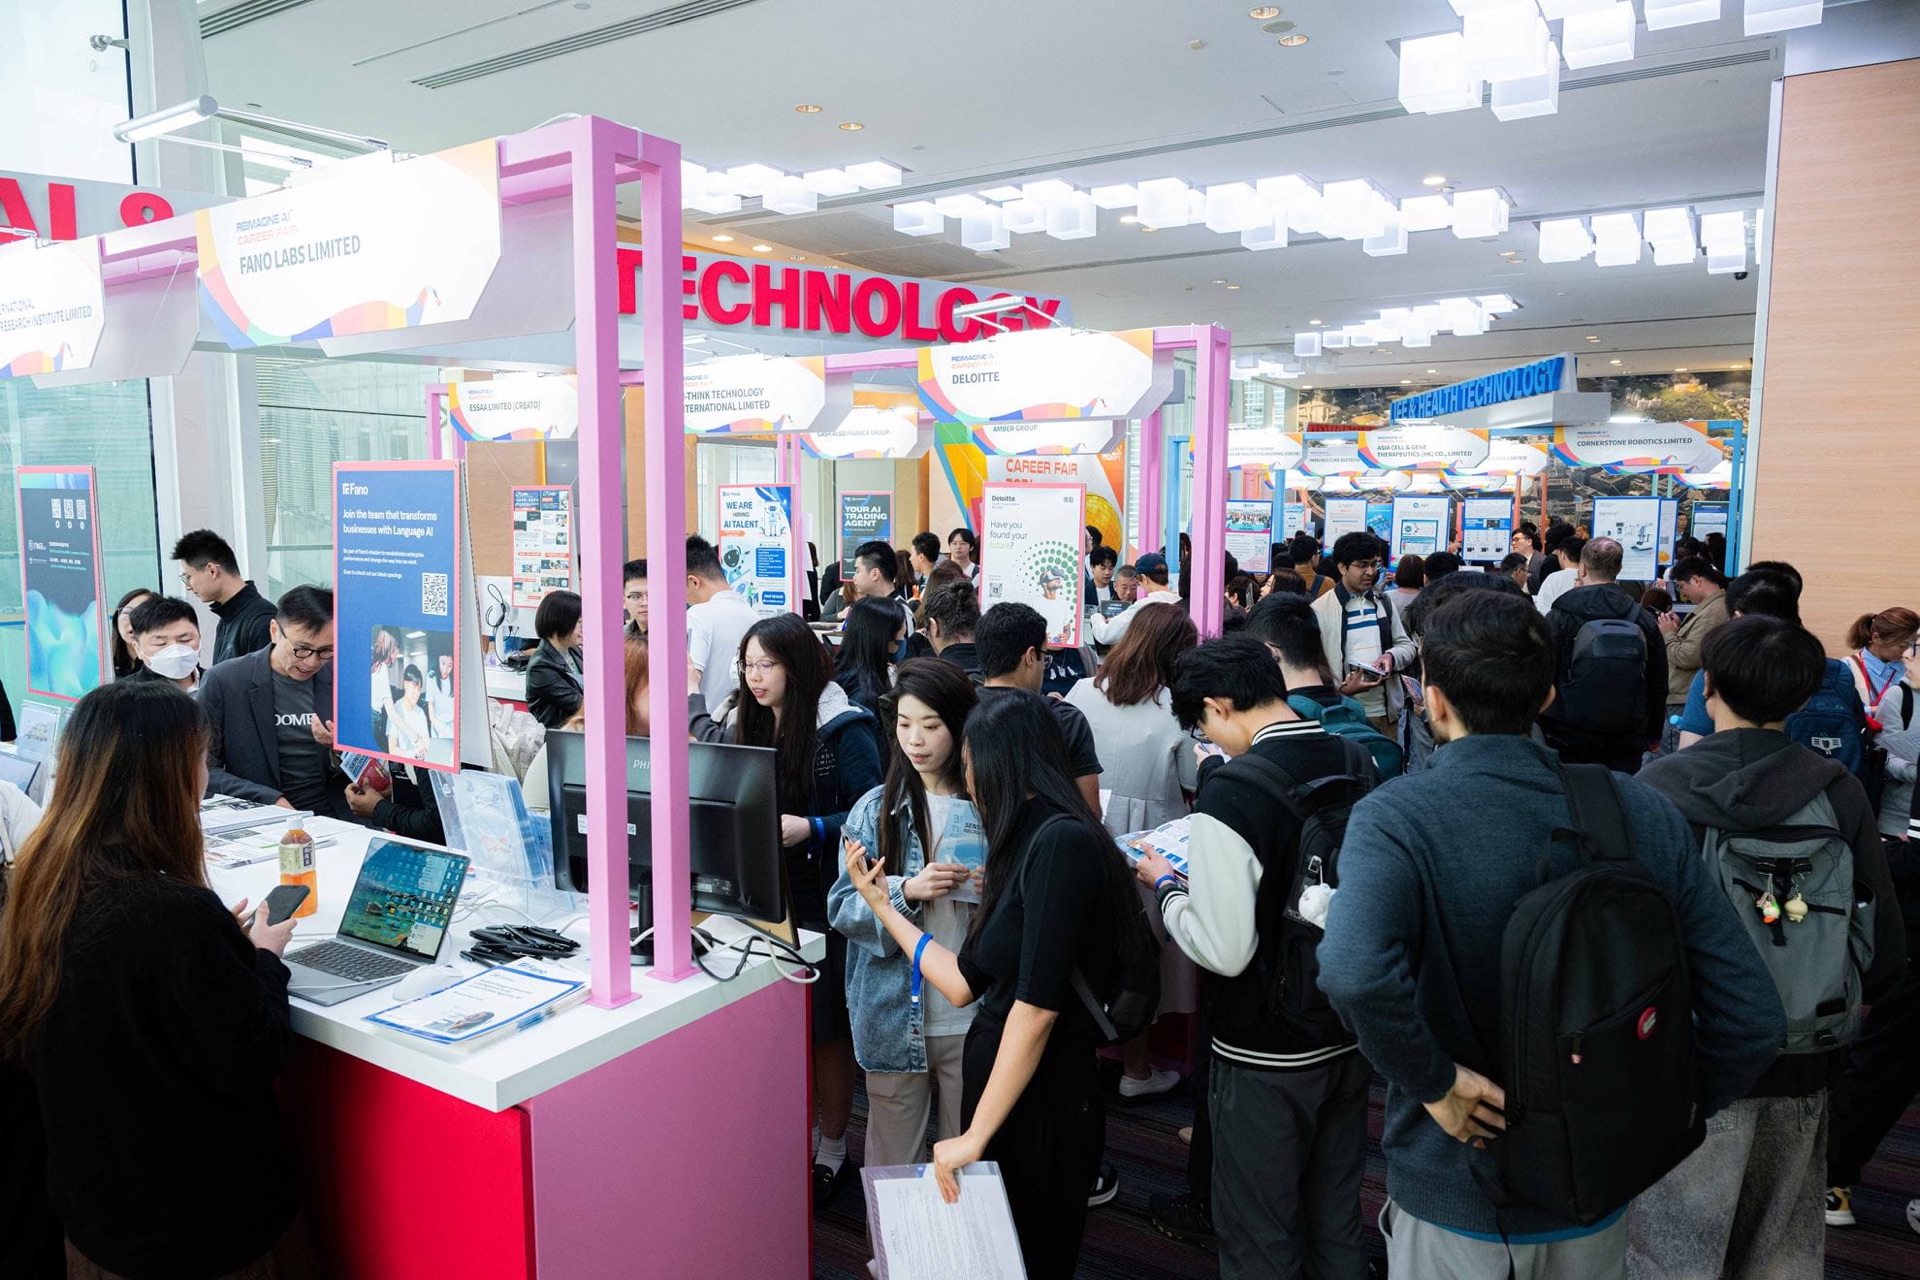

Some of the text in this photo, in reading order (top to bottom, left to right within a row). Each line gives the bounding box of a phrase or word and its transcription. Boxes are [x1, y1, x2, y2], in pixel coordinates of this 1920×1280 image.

[236, 214, 280, 233] REIMAGINE
[237, 230, 274, 246] CAREER
[240, 235, 360, 274] FANO LABS LIMITED
[32, 309, 64, 327] INSTITUTE
[65, 304, 92, 322] LIMITED
[952, 372, 1000, 384] DELOITTE
[712, 388, 764, 399] TECHNOLOGY
[1418, 385, 1458, 418] HEALTH
[1461, 357, 1565, 407] TECHNOLOGY
[470, 400, 540, 412] ESSAA LIMITED (CREATO)
[738, 400, 770, 410] LIMITED
[993, 424, 1038, 432] AMBER GROUP
[1577, 439, 1626, 447] CORNERSTONE
[1628, 438, 1663, 446] ROBOTICS
[1006, 458, 1078, 476] CAREER FAIR
[350, 483, 368, 495] Fano
[726, 502, 752, 510] WE ARE
[343, 510, 438, 520] Join the team that transforms
[724, 520, 758, 528] AI TALENT
[990, 520, 1022, 530] Have you
[343, 524, 433, 538] businesses with Language AI
[990, 530, 1028, 540] found your
